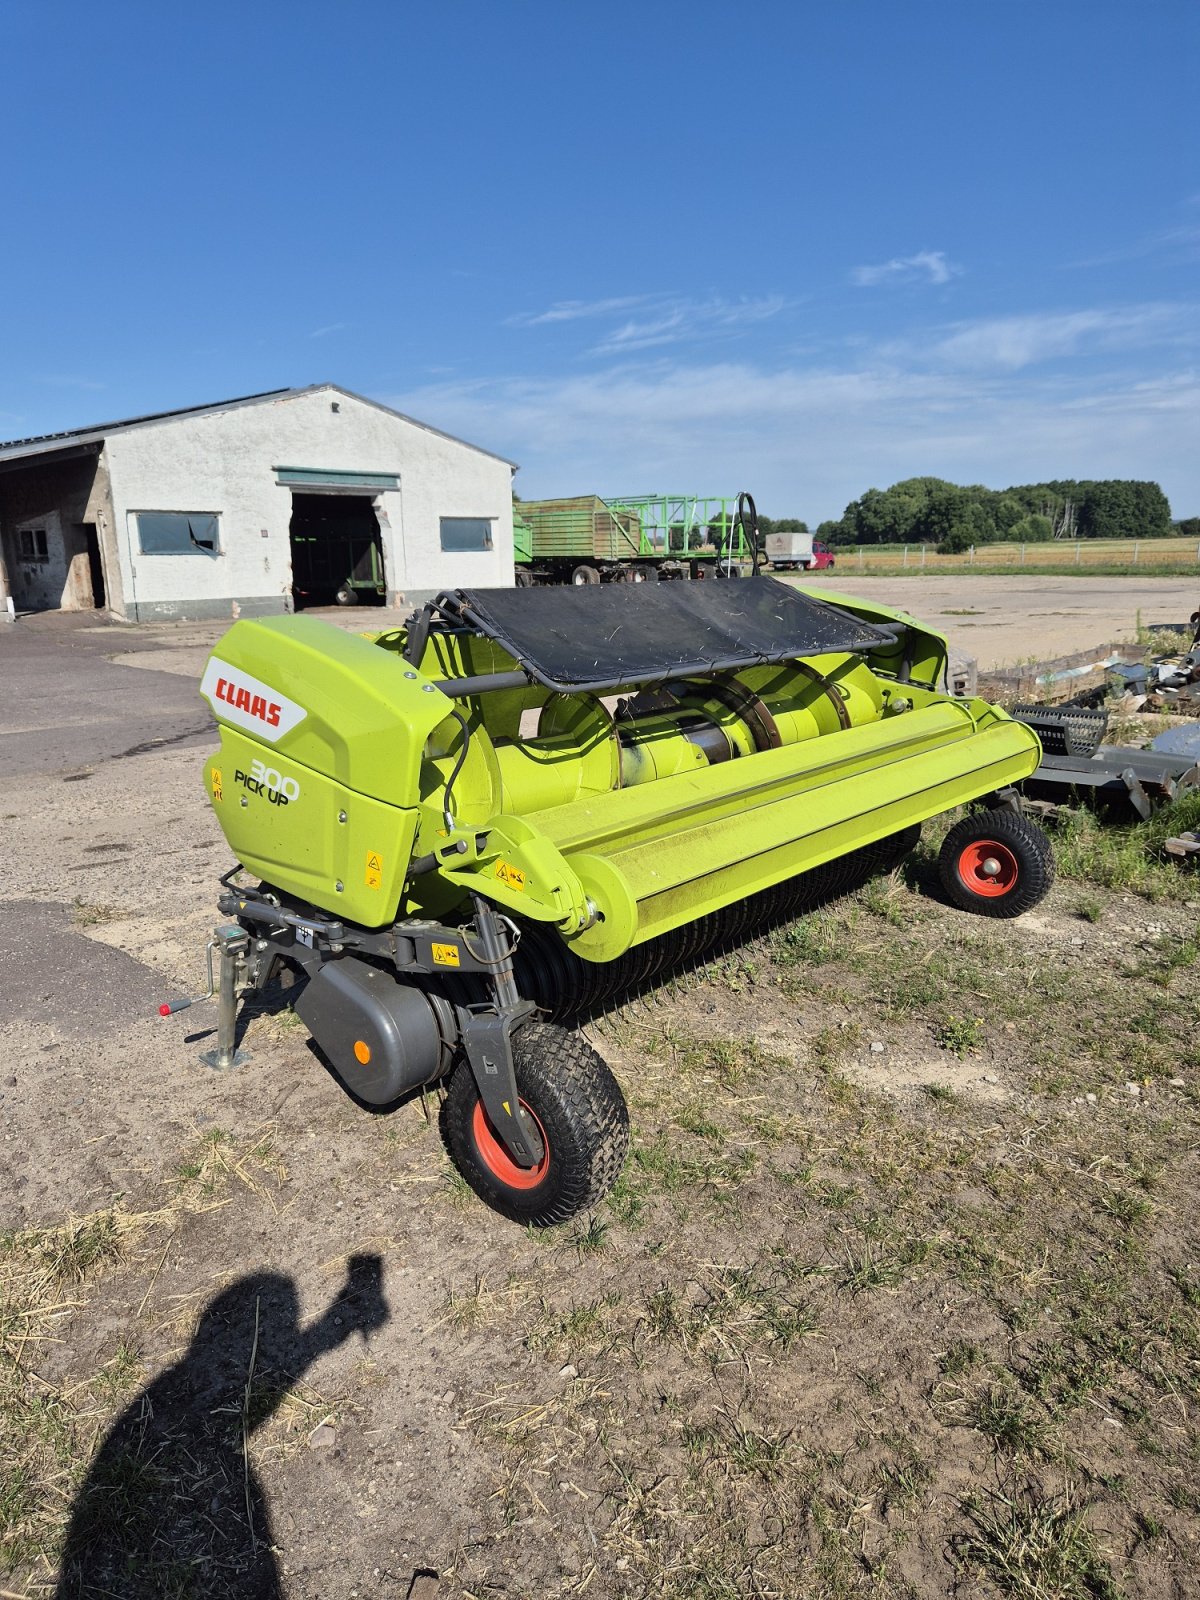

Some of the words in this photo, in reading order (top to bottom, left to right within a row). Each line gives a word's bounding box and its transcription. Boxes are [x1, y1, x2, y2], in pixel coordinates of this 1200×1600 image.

[216, 679, 281, 727] CLAAS
[234, 769, 265, 798] PICK
[268, 788, 288, 806] UP
[251, 759, 300, 801] 300
